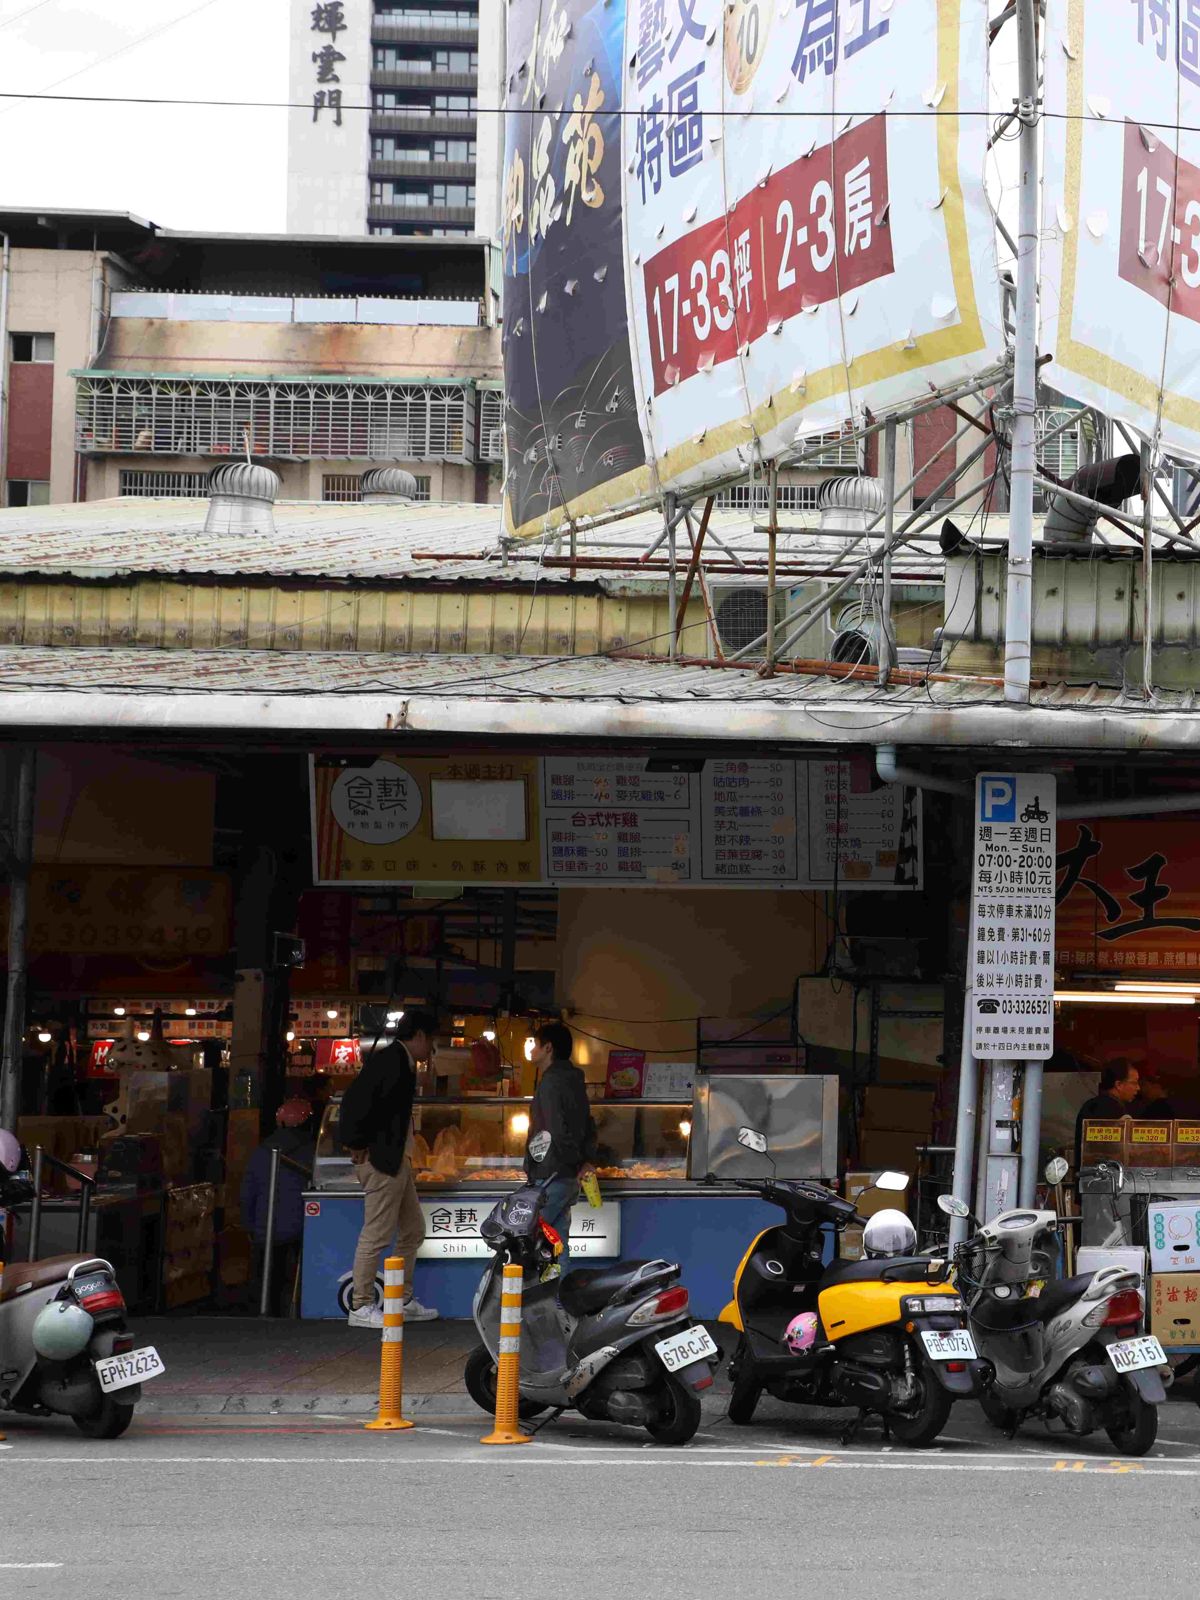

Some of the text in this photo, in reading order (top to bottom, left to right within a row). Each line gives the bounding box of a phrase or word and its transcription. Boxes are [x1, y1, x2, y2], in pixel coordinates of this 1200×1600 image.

[311, 1, 347, 126] 輝雲門
[636, 60, 706, 205] 特區
[653, 156, 873, 363] 17-33坪 2-3房
[714, 791, 738, 802] 地瓜
[985, 781, 1012, 818] P
[571, 812, 639, 828] 台式炸雞
[979, 826, 1051, 842] 週一至週日
[595, 848, 608, 857] 50
[985, 843, 1010, 852] Mon.
[1022, 844, 1045, 853] Sun.
[978, 854, 1052, 868] 07:00-20:00
[979, 870, 1052, 885] 每小時10元
[978, 886, 1052, 894] NT$ 5/30 MINUTES
[977, 904, 1052, 919] 每次停車未滿30分
[1002, 1000, 1051, 1014] 03-3326521
[443, 1243, 467, 1253] Shih
[75, 1281, 104, 1295] gogoro
[663, 1335, 709, 1366] 678-CJF
[1113, 1345, 1162, 1368] AU2-151
[100, 1354, 159, 1385] EPH-2623
